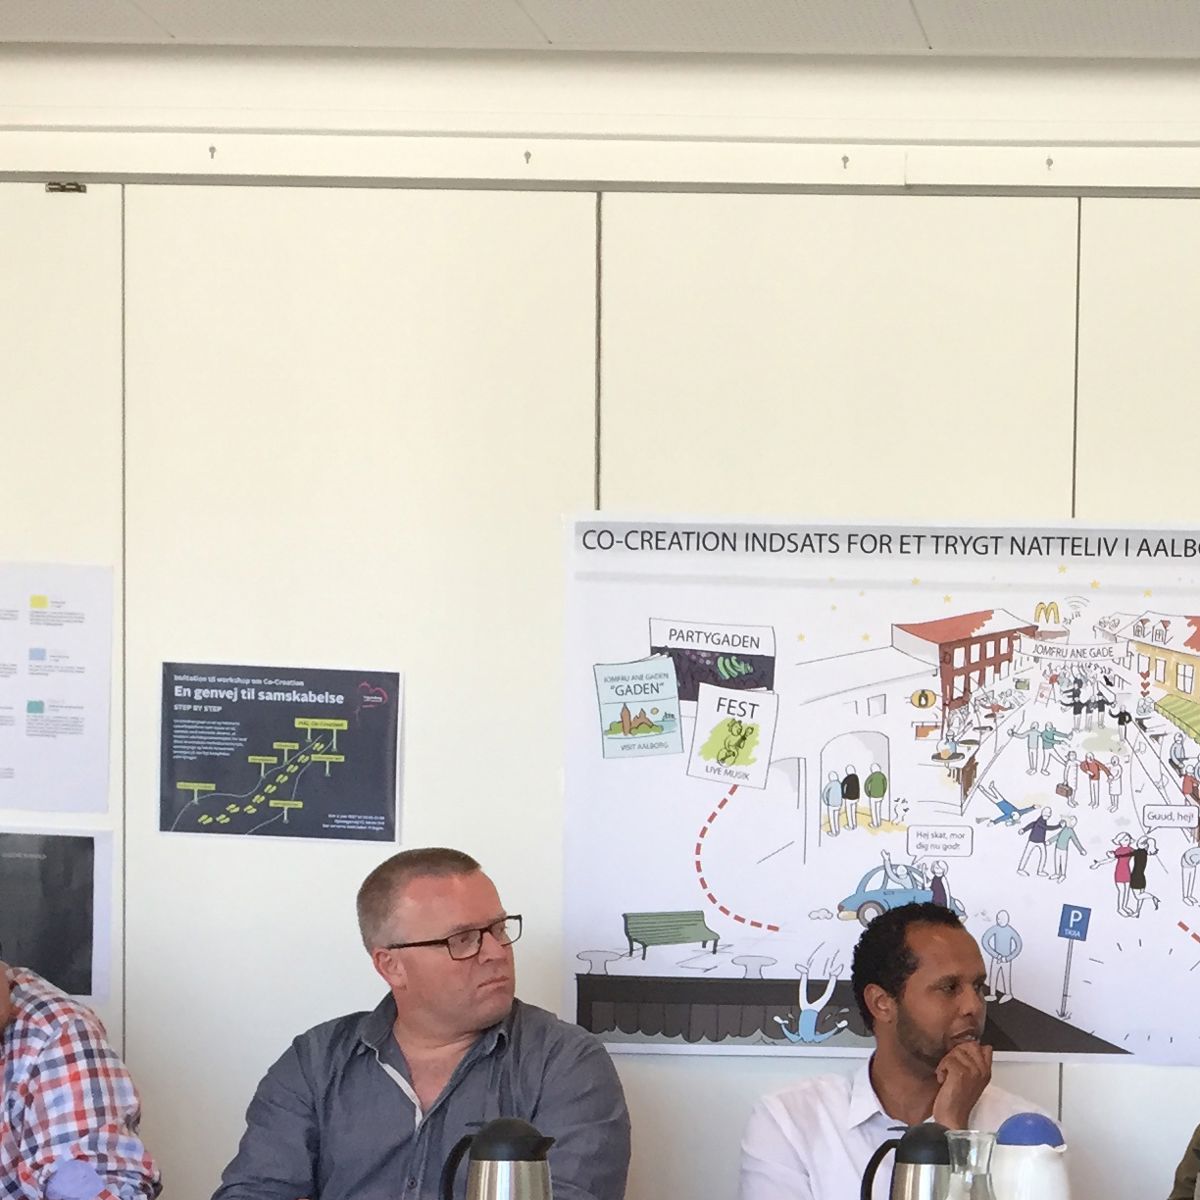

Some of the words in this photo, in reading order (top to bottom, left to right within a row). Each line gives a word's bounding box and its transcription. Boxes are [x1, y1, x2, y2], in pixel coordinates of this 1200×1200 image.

[582, 529, 737, 552] CO-CREATION
[744, 531, 840, 554] INDSATS
[848, 533, 892, 554] FOR
[899, 534, 926, 555] ET
[930, 535, 1003, 557] TRYGT
[1011, 536, 1119, 557] NATTELIV
[668, 628, 760, 649] PARTYGADEN
[1032, 644, 1068, 658] JOMFRU
[1070, 648, 1087, 658] ANE
[1089, 647, 1114, 658] GADE
[174, 685, 191, 697] En
[194, 687, 238, 702] genvej
[241, 688, 255, 700] til
[258, 690, 344, 704] samskabelse
[716, 697, 759, 719] FEST
[705, 765, 722, 776] LIVE
[723, 768, 750, 781] MUSIK
[1147, 811, 1175, 822] Guud,
[1070, 910, 1082, 928] P
